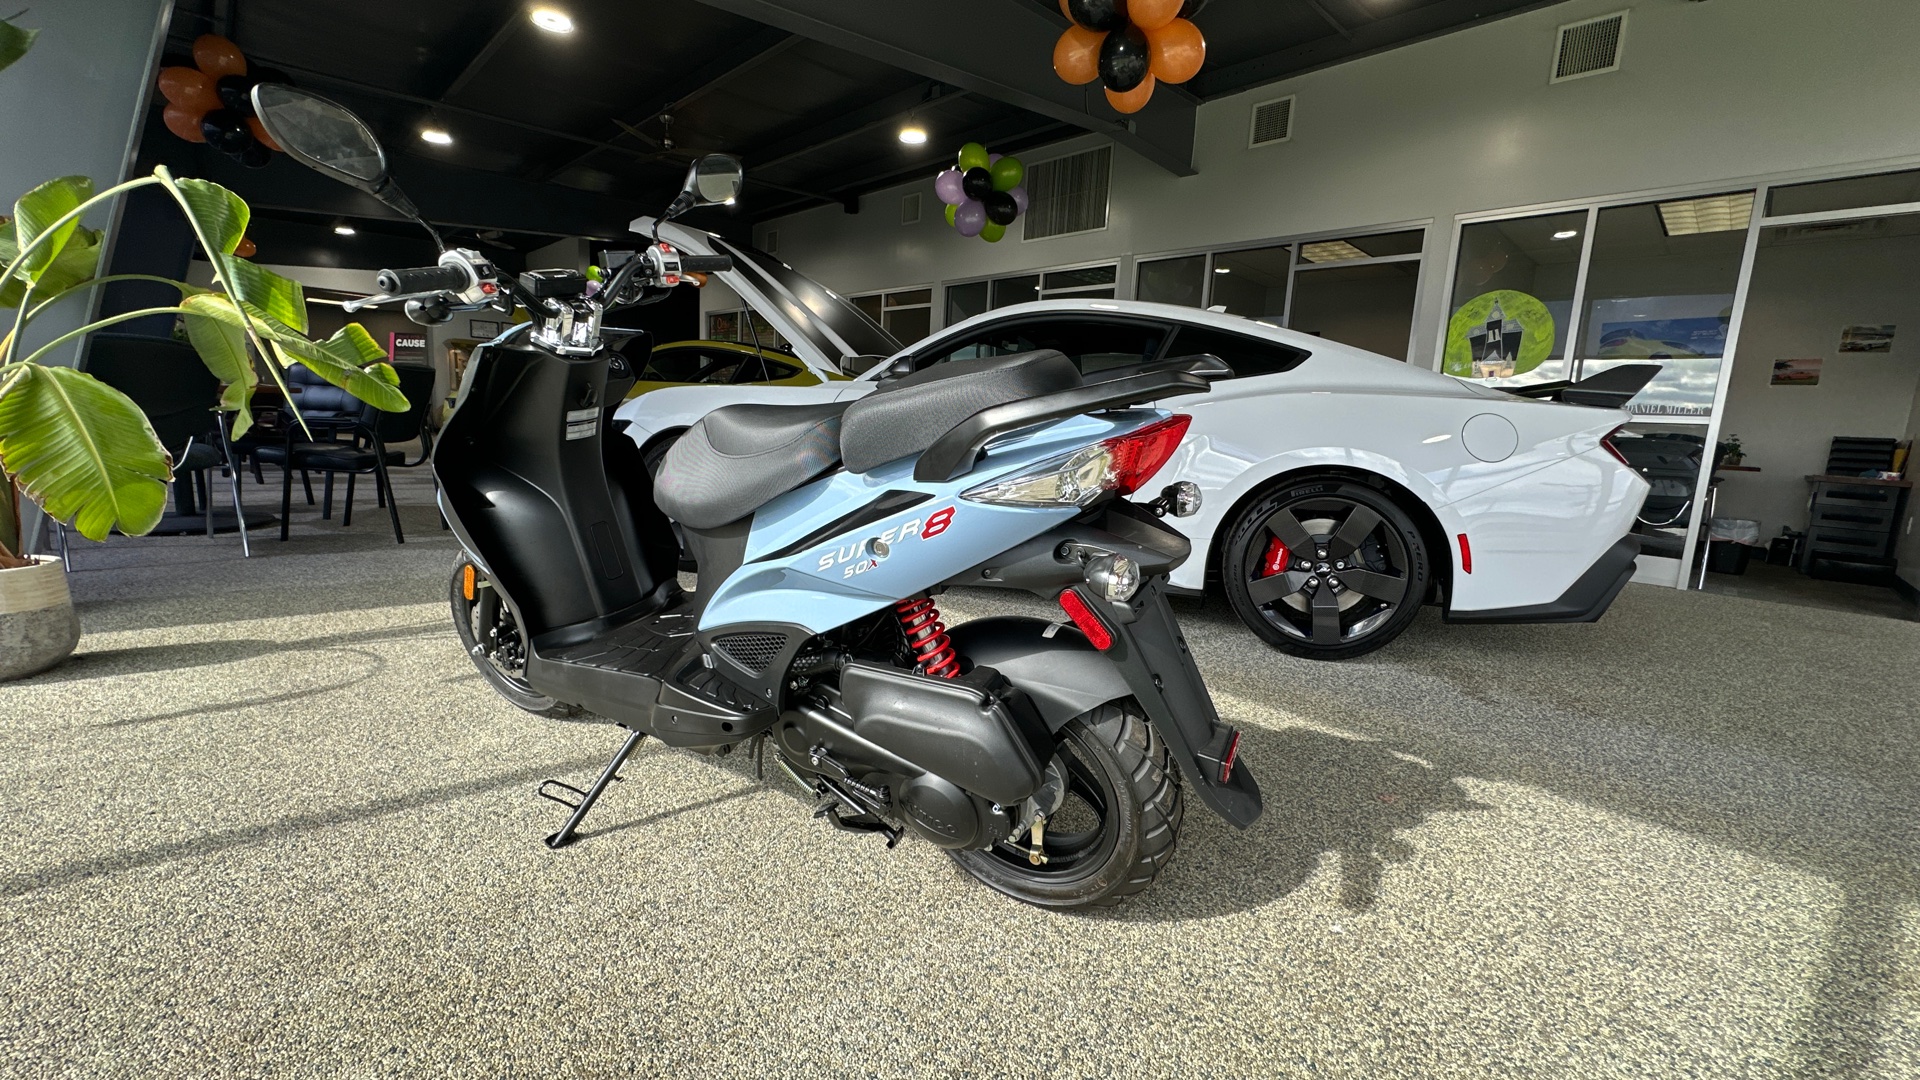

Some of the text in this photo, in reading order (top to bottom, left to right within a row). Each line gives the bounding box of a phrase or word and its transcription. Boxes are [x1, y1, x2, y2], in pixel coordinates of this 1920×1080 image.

[395, 338, 426, 348] CAUSE
[1627, 404, 1704, 415] DANIEL MILLER
